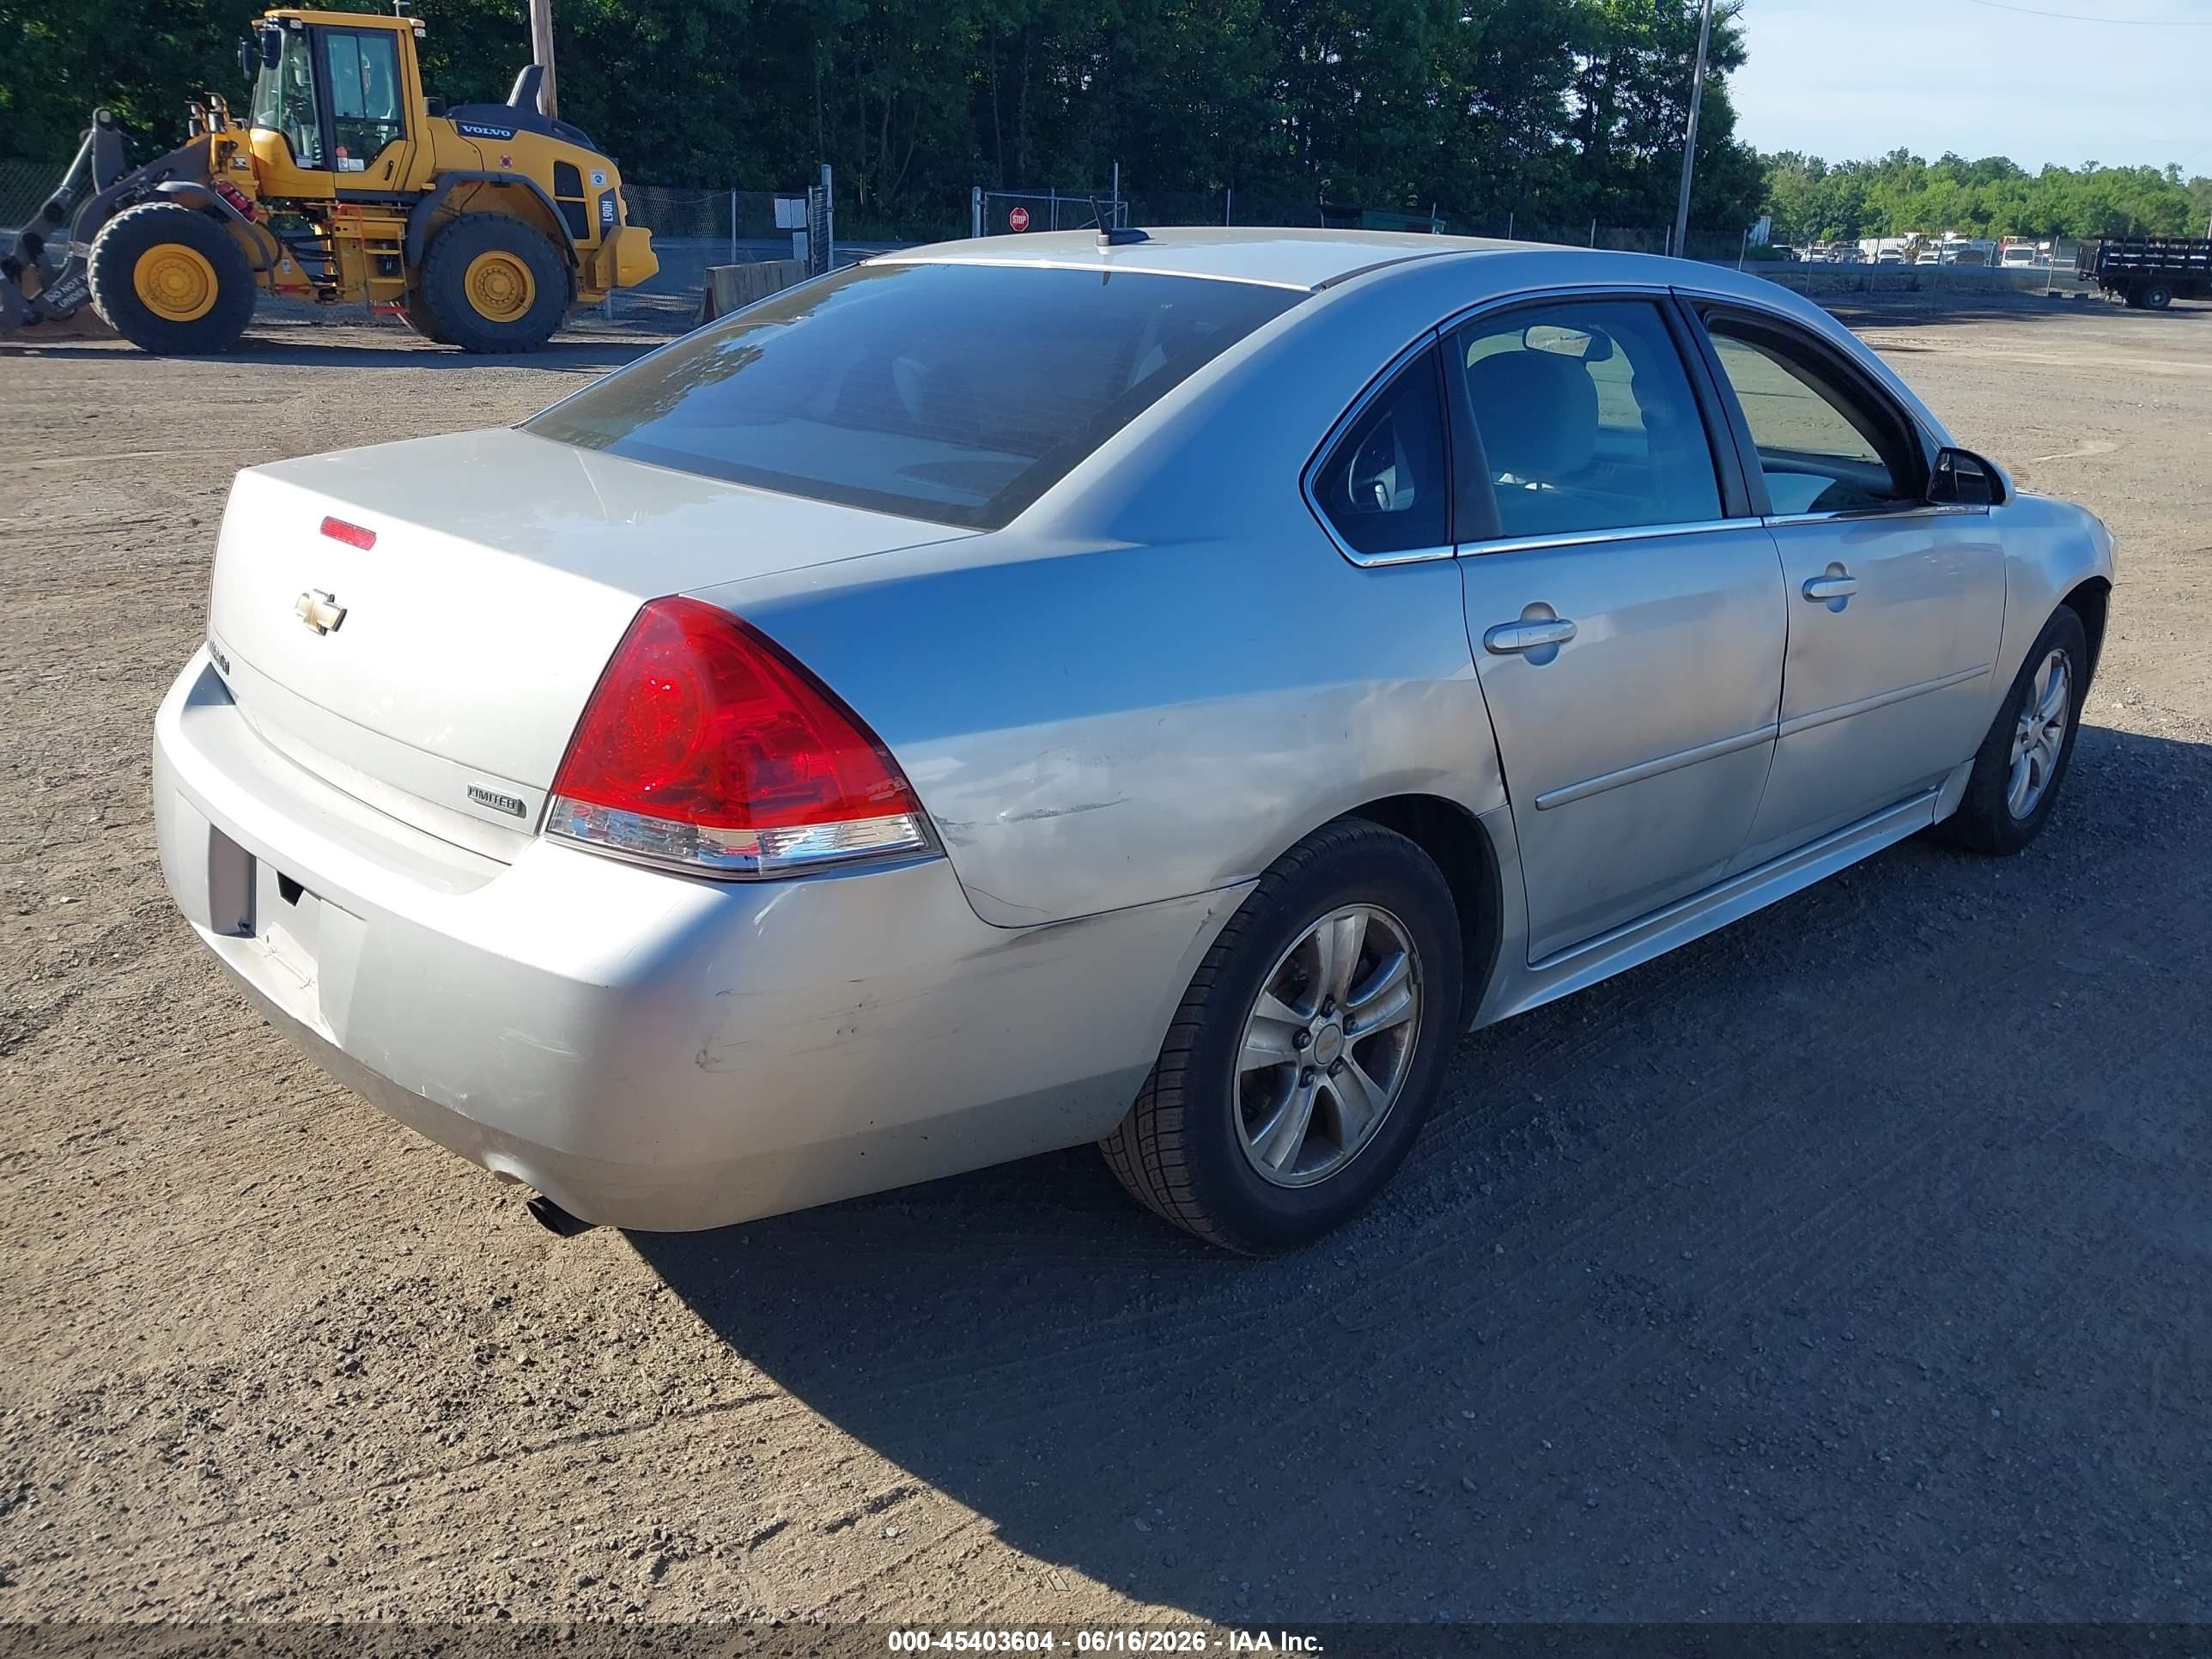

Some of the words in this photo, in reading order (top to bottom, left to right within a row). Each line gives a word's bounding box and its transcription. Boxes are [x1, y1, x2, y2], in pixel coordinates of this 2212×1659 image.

[461, 125, 511, 137] VOLVO
[602, 200, 614, 222] L90H
[1012, 215, 1027, 225] STOP
[43, 290, 63, 303] DO
[60, 277, 81, 294] NOT
[468, 785, 517, 810] LIMITED
